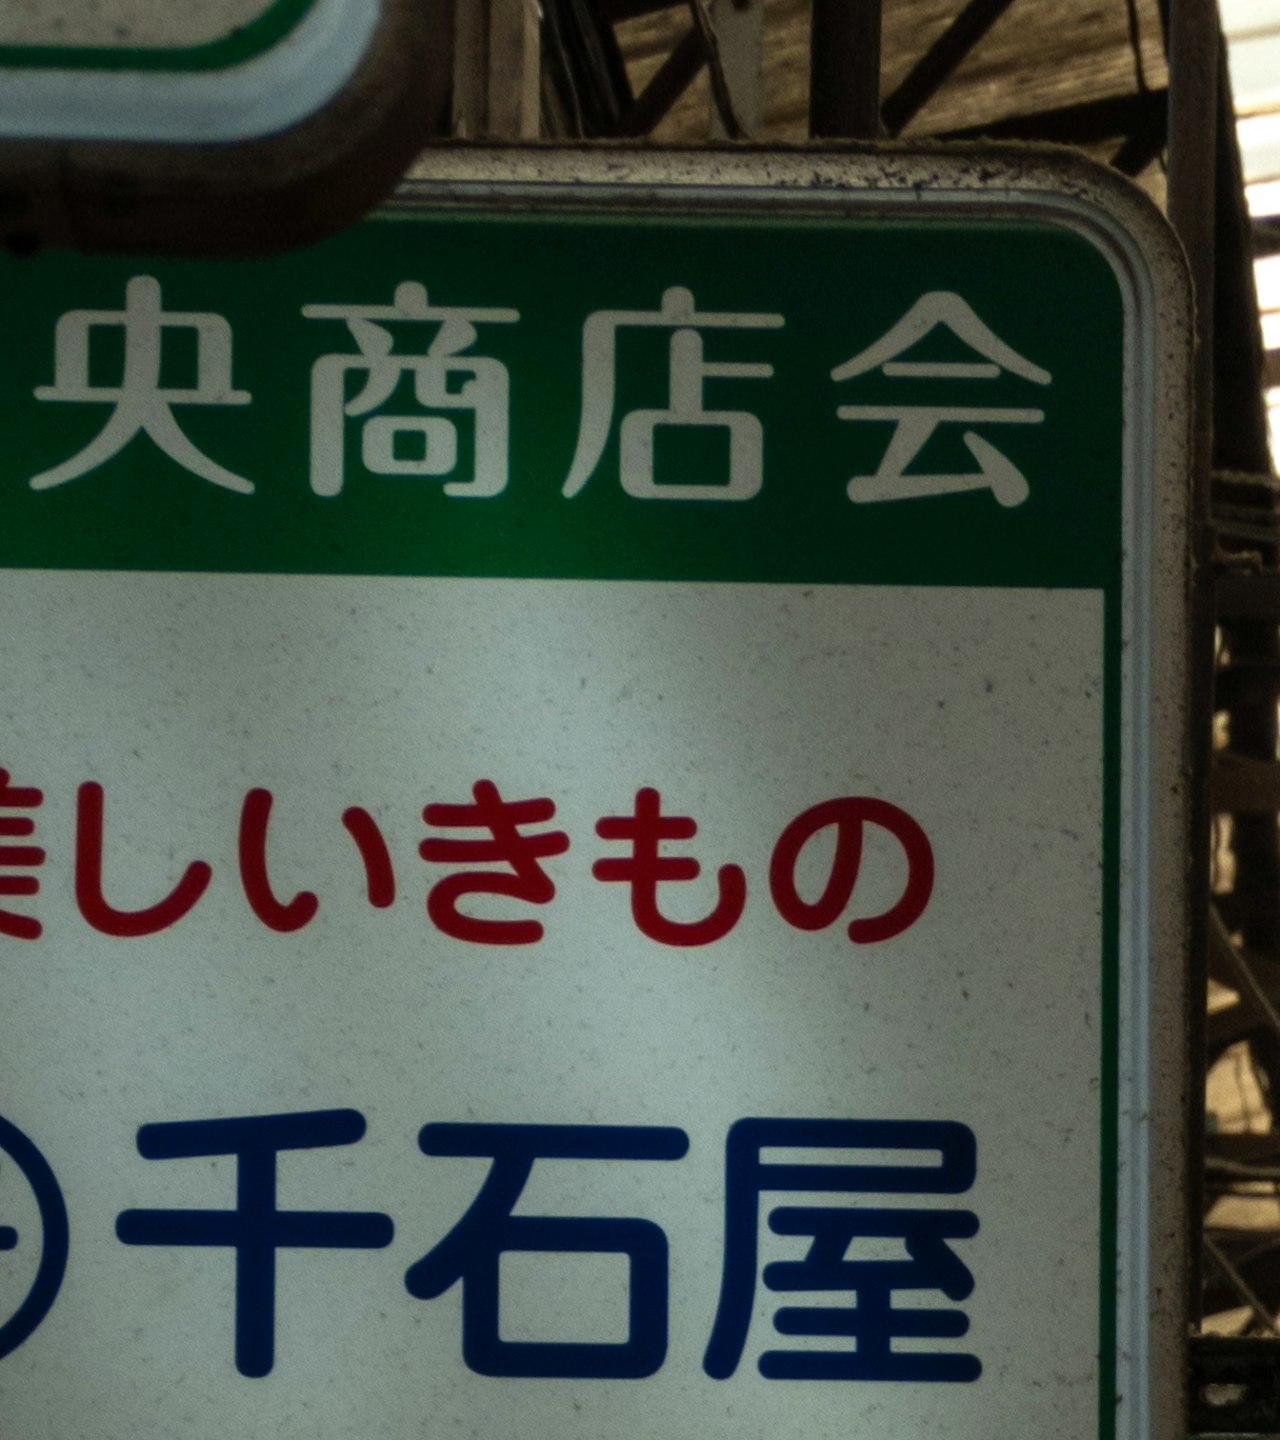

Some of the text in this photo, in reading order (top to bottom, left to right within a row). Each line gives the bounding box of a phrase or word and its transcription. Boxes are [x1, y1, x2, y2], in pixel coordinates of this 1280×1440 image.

[28, 273, 1055, 508] 央商店会
[0, 769, 935, 947] しいきもの
[115, 1107, 983, 1384] 千石屋
